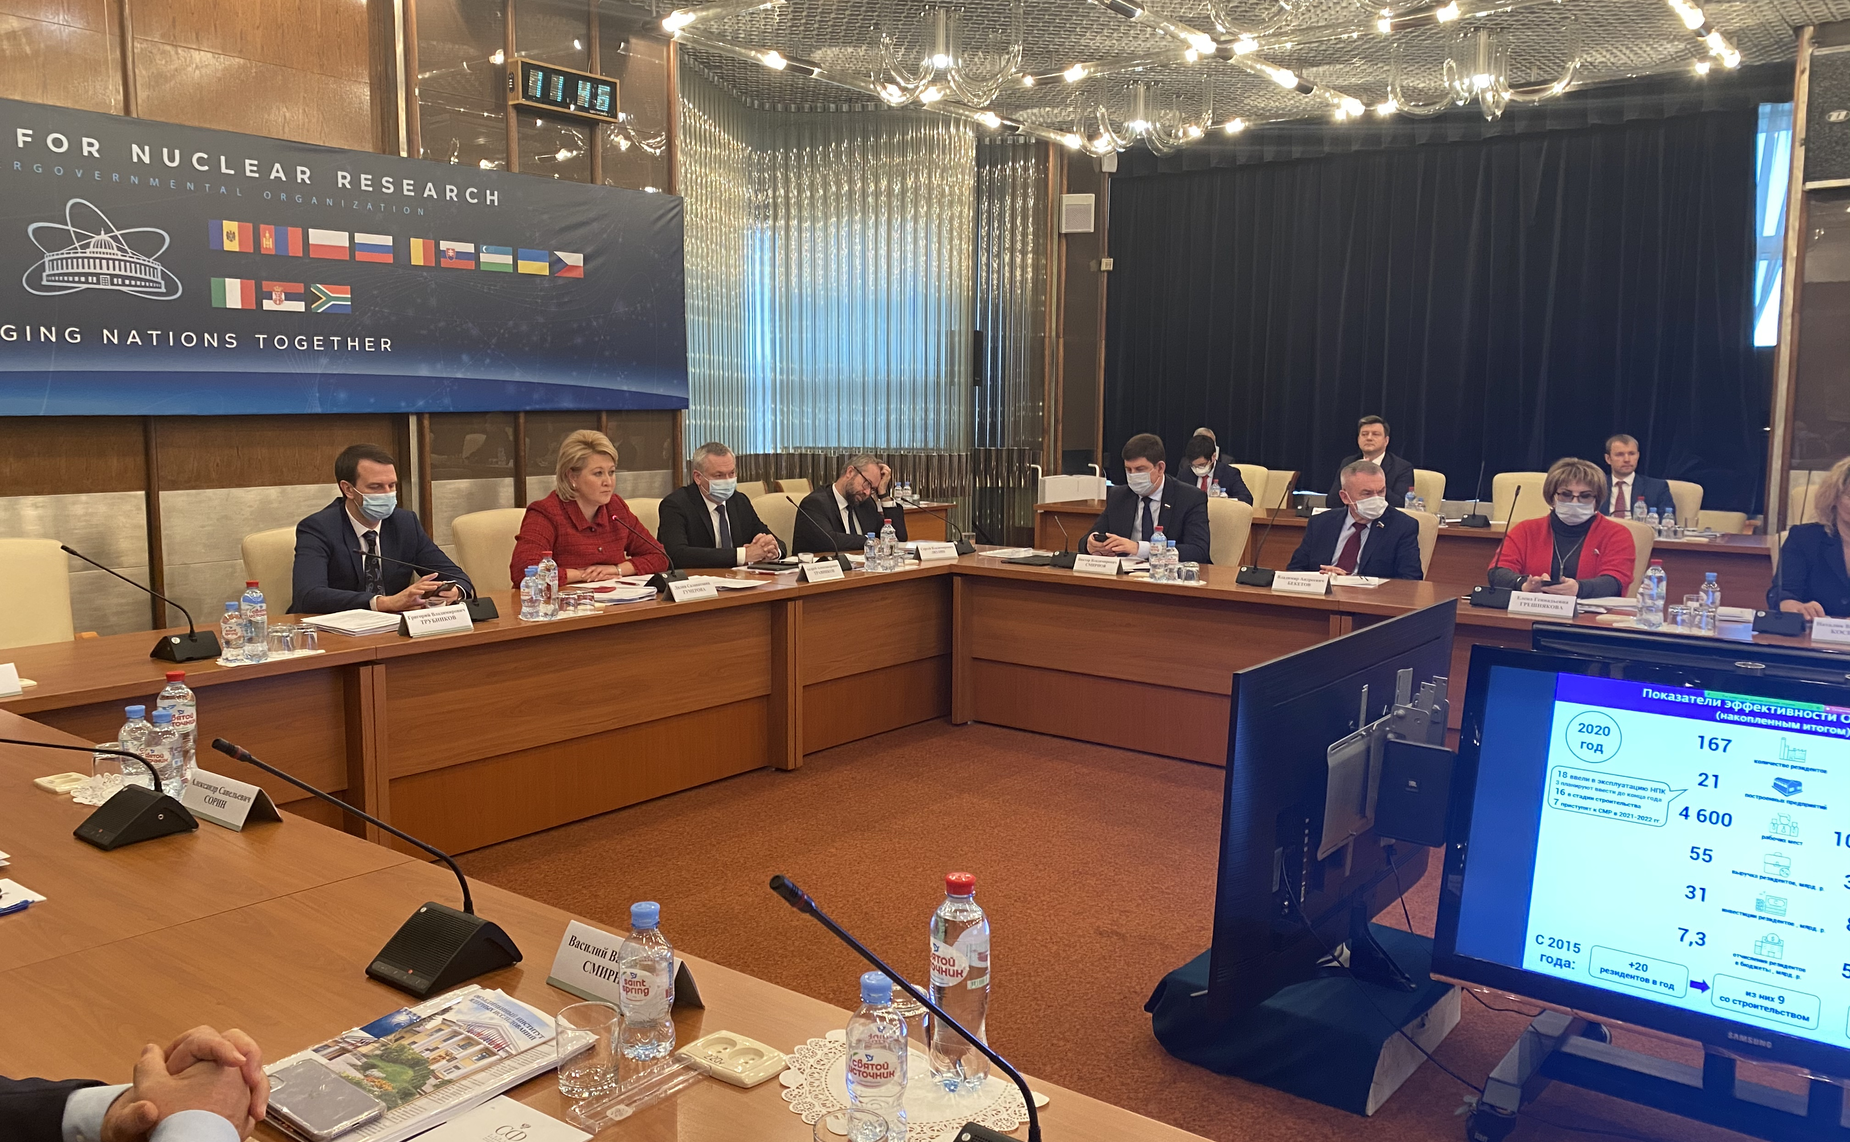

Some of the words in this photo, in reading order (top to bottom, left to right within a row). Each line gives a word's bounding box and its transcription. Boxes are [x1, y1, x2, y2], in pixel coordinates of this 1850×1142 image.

[16, 128, 100, 158] FOR
[131, 143, 311, 185] NUCLEAR
[337, 171, 499, 206] RESEARCH
[263, 191, 425, 216] ORGANIZATION
[0, 324, 81, 343] GING
[103, 329, 238, 348] NATIONS
[255, 334, 392, 352] TOGETHER
[1642, 687, 1722, 707] Показатели
[1724, 699, 1837, 722] эффективности
[1577, 722, 1611, 737] 2020
[1716, 710, 1800, 730] (накопленным
[1802, 722, 1850, 738] итогом)
[1580, 741, 1604, 755] год
[1697, 735, 1733, 753] 167
[1557, 770, 1568, 779] 18
[1597, 779, 1649, 792] эксплуатацию
[1650, 787, 1667, 795] НПК
[1697, 772, 1720, 789] 21
[203, 795, 228, 809] СОРИН
[1555, 787, 1566, 796] 16
[1572, 793, 1594, 801] стадии
[1553, 798, 1559, 806] 7
[1619, 811, 1653, 823] 2021-2022
[1678, 806, 1691, 820] 4
[1696, 808, 1733, 828] 600
[1689, 846, 1714, 863] 55
[1684, 884, 1707, 902] 31
[1535, 934, 1544, 946] С
[1547, 936, 1582, 954] 2015
[1677, 926, 1707, 947] 7,3
[568, 934, 608, 960] Василий
[1539, 953, 1576, 971] года:
[1627, 960, 1649, 973] +20
[582, 960, 620, 985] СМИРН
[1599, 966, 1650, 985] резидентов
[1658, 980, 1675, 991] год
[622, 985, 650, 997] spring
[623, 978, 647, 987] saint
[1719, 994, 1731, 1003] со
[1732, 997, 1810, 1023] строительством
[1758, 993, 1775, 1002] них
[1777, 994, 1786, 1005] 9
[1728, 1031, 1773, 1048] SAMSUNG
